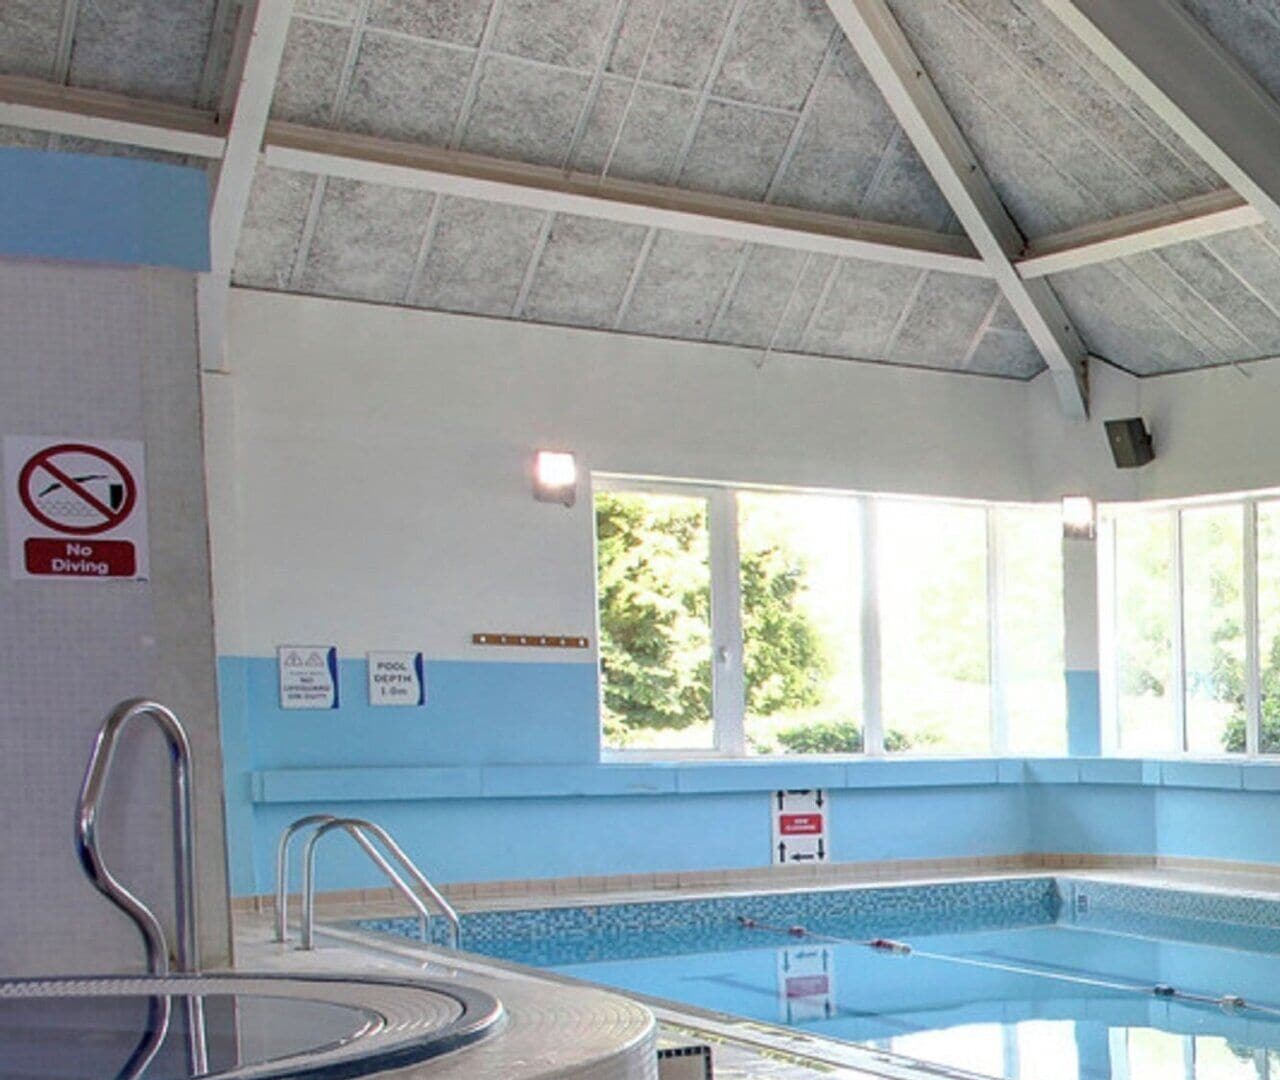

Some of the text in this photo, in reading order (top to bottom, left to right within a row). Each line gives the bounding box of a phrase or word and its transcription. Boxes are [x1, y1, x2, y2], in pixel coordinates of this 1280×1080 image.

[66, 543, 93, 557] No
[52, 558, 109, 575] Diving
[377, 661, 408, 671] POOL
[374, 674, 412, 683] DEPTH
